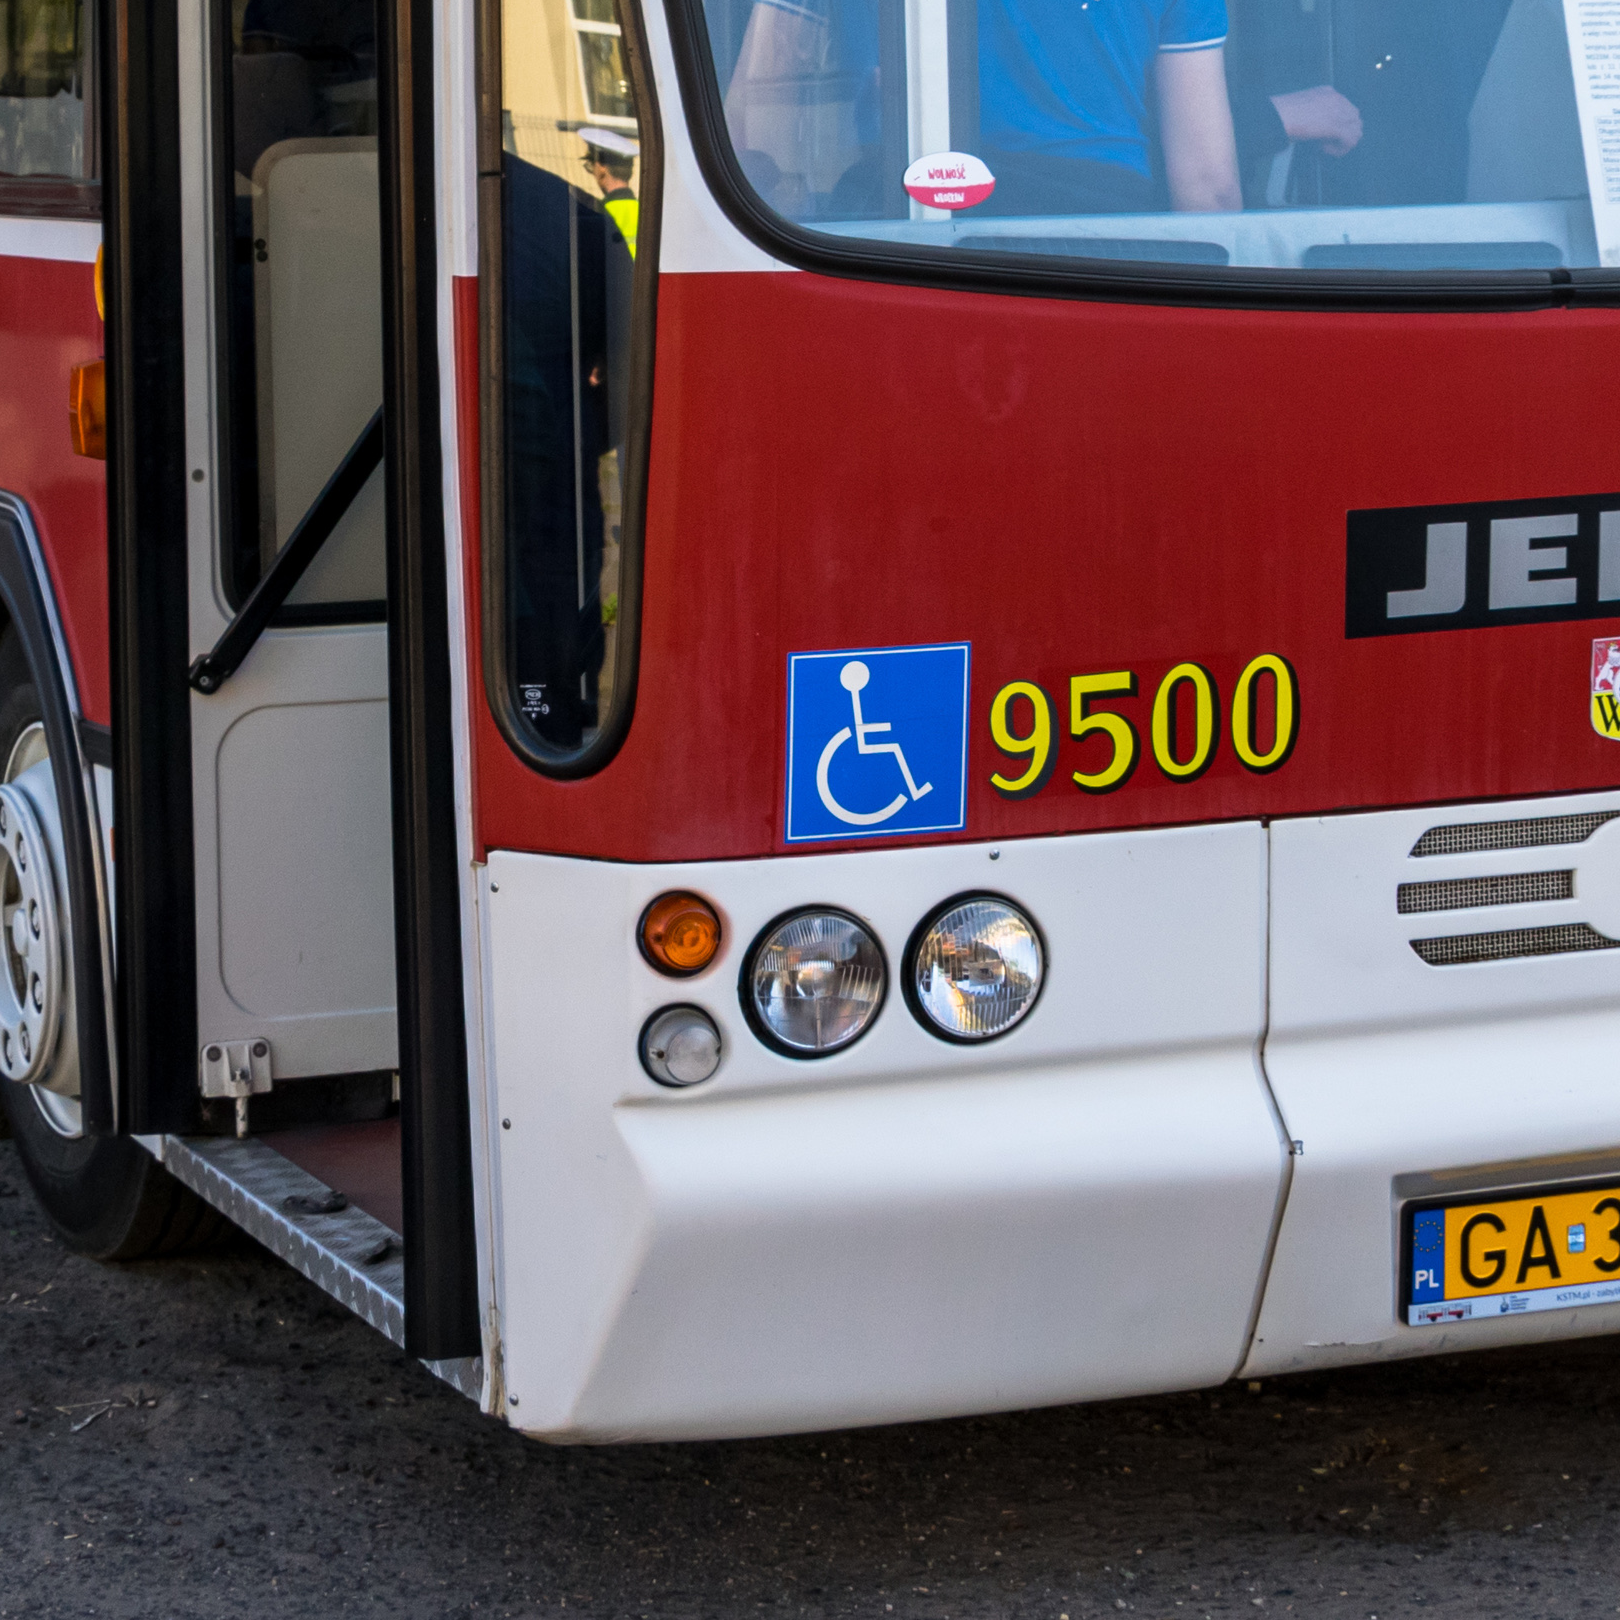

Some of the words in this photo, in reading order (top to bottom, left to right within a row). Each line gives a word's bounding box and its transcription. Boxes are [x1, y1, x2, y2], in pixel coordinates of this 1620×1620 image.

[989, 653, 1299, 800] 9500
[1460, 1205, 1561, 1288] GA
[1414, 1269, 1440, 1290] PL
[1556, 1290, 1591, 1302] KSTM.pl
